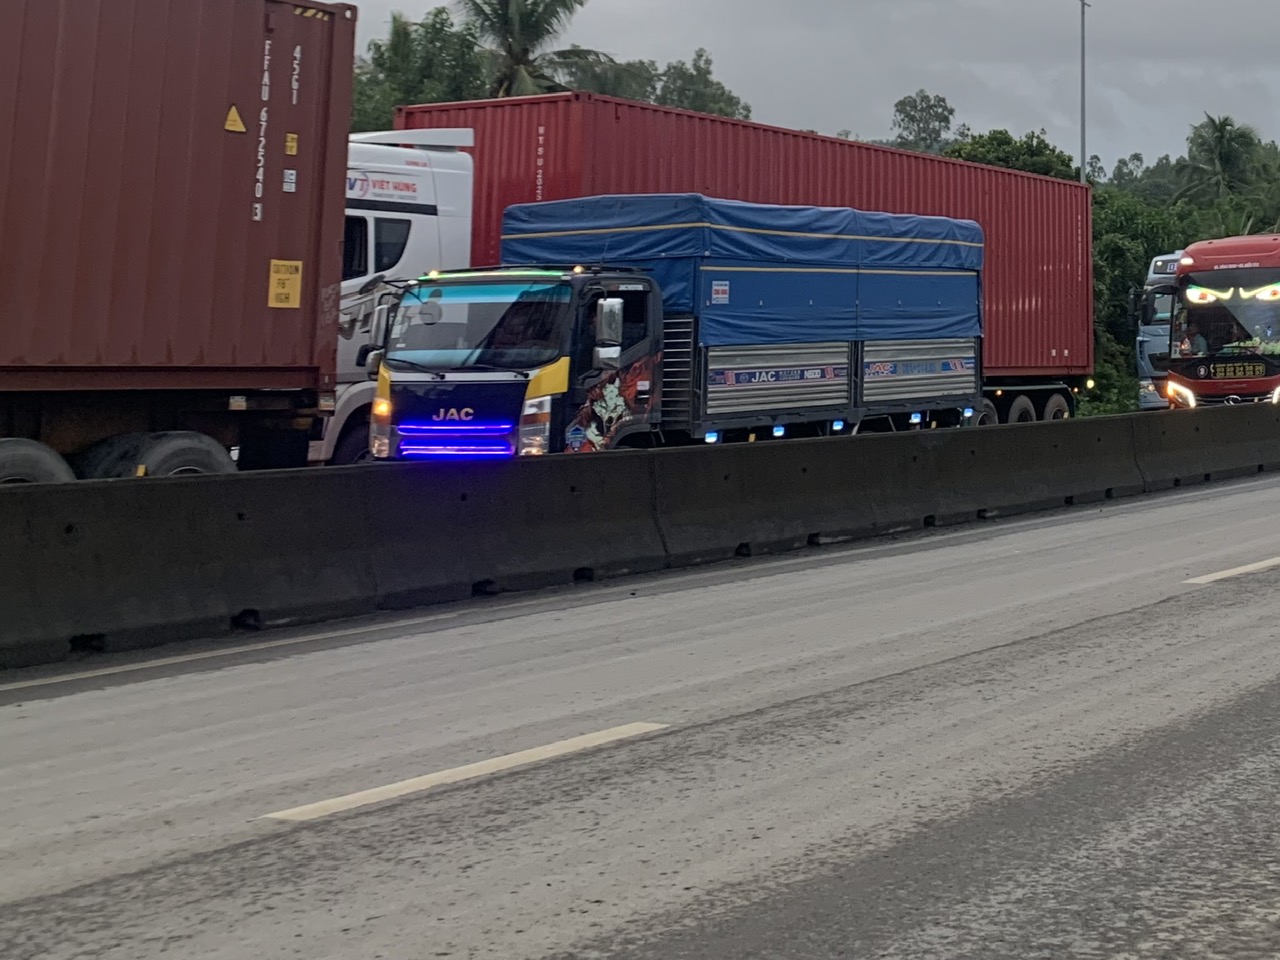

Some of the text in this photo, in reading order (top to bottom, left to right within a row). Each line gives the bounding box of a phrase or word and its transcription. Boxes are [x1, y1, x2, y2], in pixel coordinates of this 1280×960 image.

[252, 40, 272, 221] FFAU 672540 3
[752, 371, 776, 382] JAC
[432, 407, 474, 421] JAC
